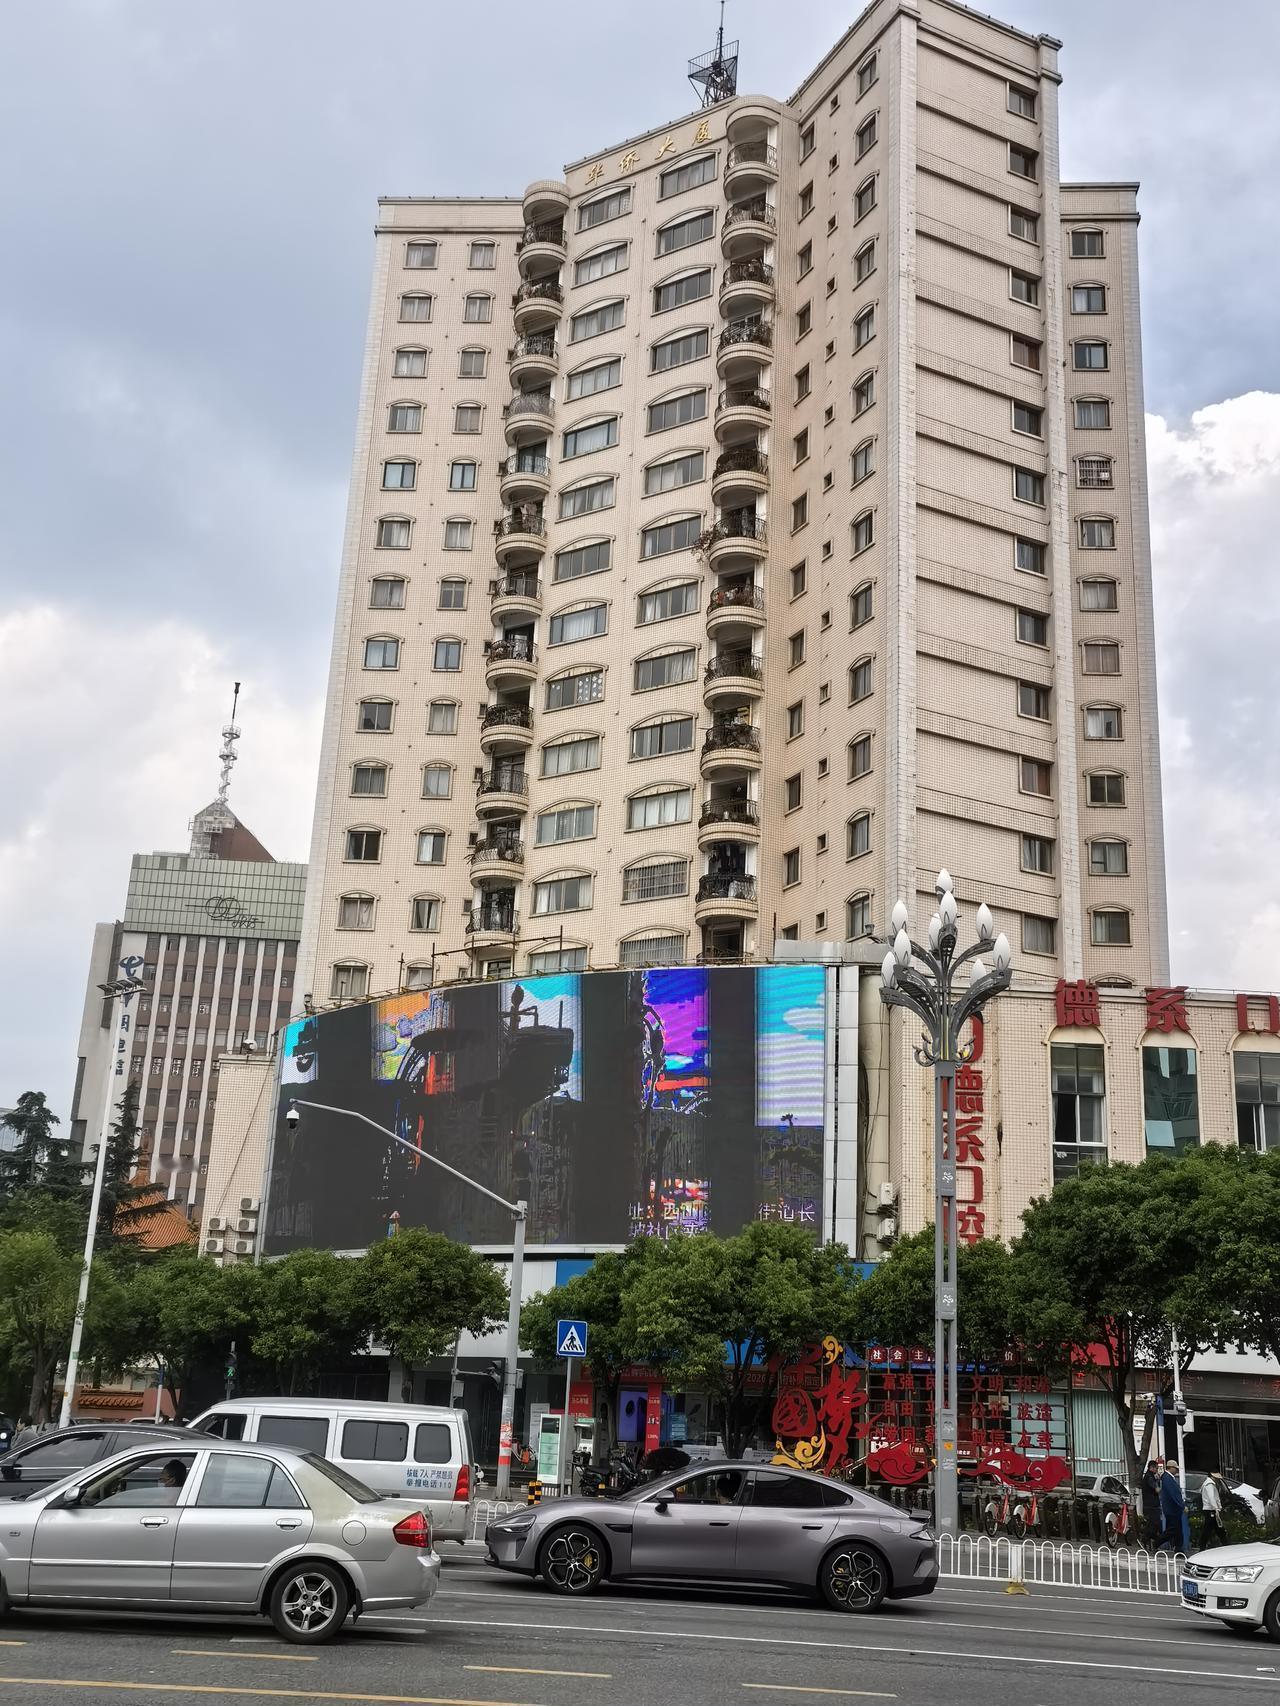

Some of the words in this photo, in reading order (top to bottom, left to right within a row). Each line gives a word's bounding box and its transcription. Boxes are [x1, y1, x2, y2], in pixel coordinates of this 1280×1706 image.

[585, 120, 712, 186] 华侨大厦
[1055, 978, 1280, 1034] 德系口
[882, 1375, 914, 1390] 富强
[971, 1375, 1003, 1392] 文明
[1016, 1375, 1051, 1392] 和谐
[884, 1400, 913, 1417] 自由
[970, 1401, 1005, 1420] 公正
[1018, 1403, 1052, 1420] 法治
[1018, 1430, 1053, 1449] 友善
